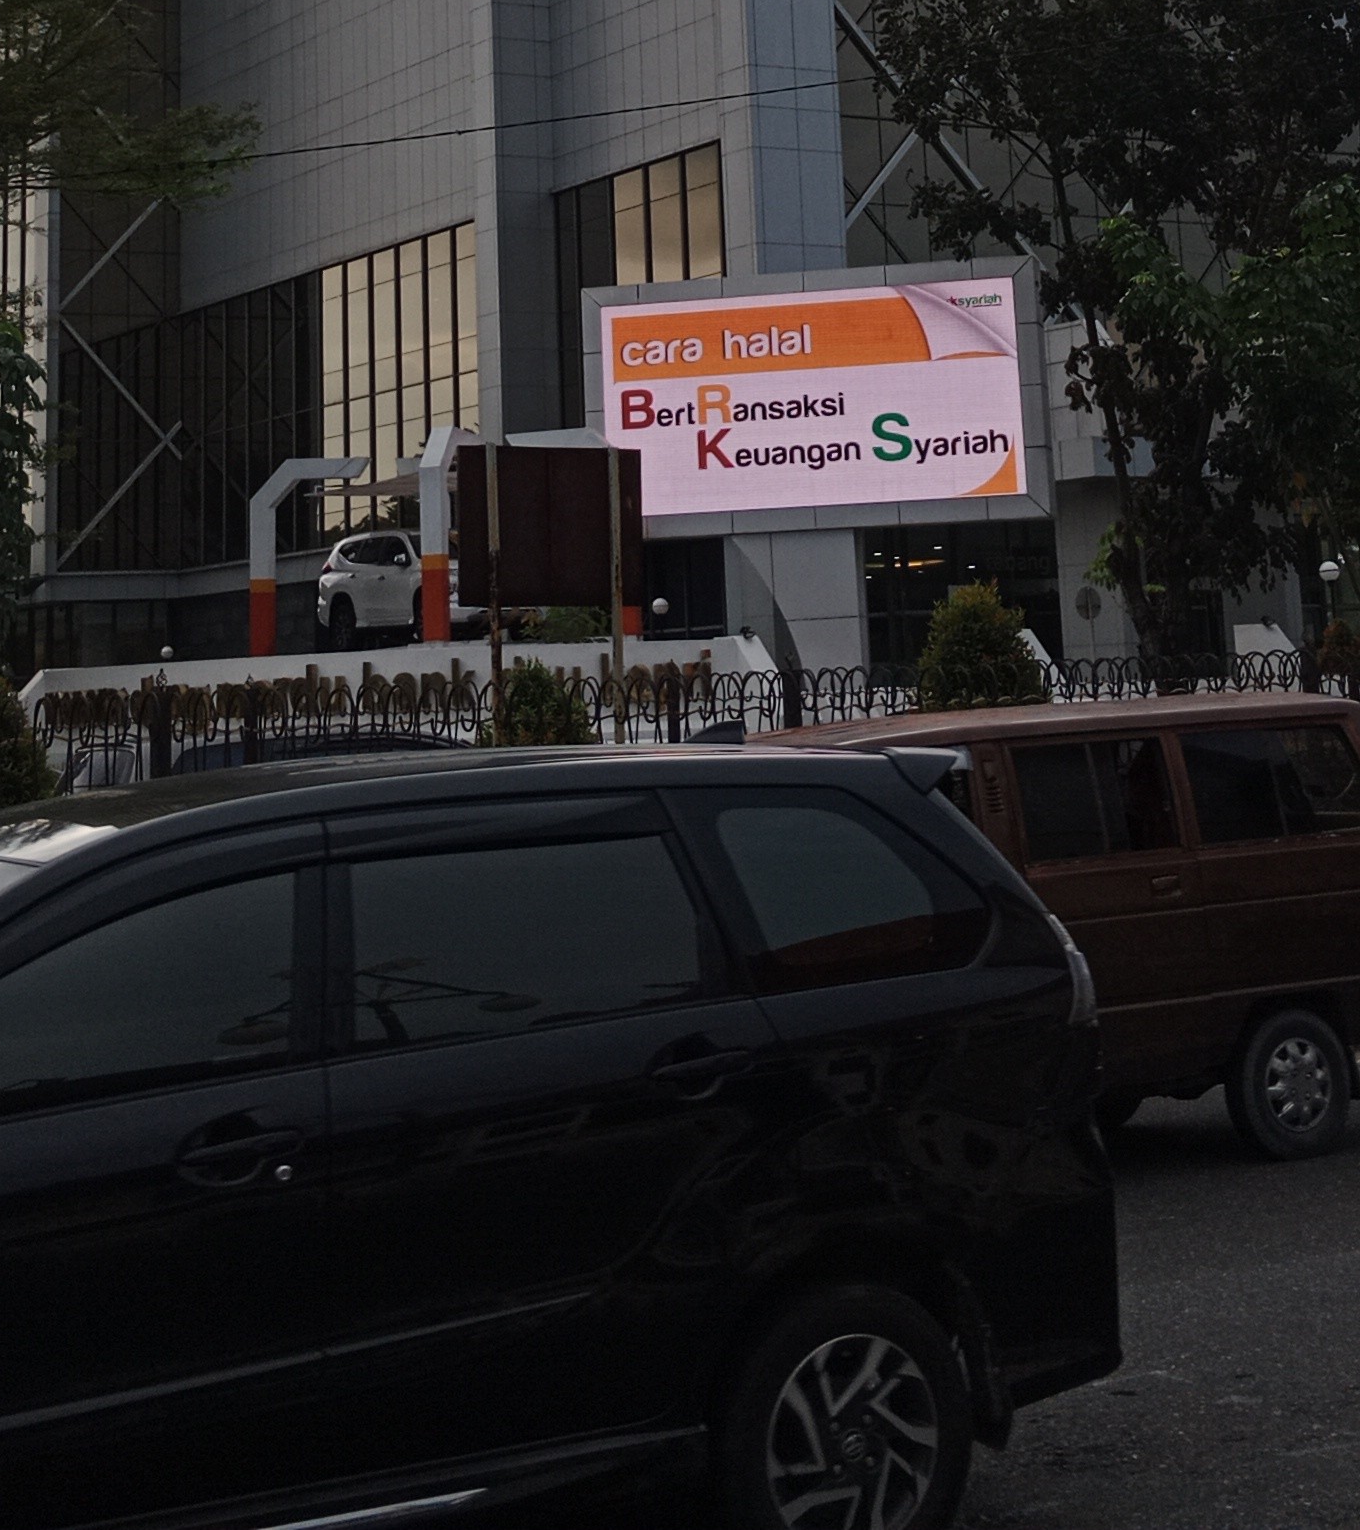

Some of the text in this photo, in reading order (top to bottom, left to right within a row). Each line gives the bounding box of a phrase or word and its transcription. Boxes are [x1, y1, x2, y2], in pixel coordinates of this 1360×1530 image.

[622, 323, 812, 367] cara halal
[621, 383, 846, 430] BertRansaksi
[697, 412, 1010, 470] Keuangan Syariah
